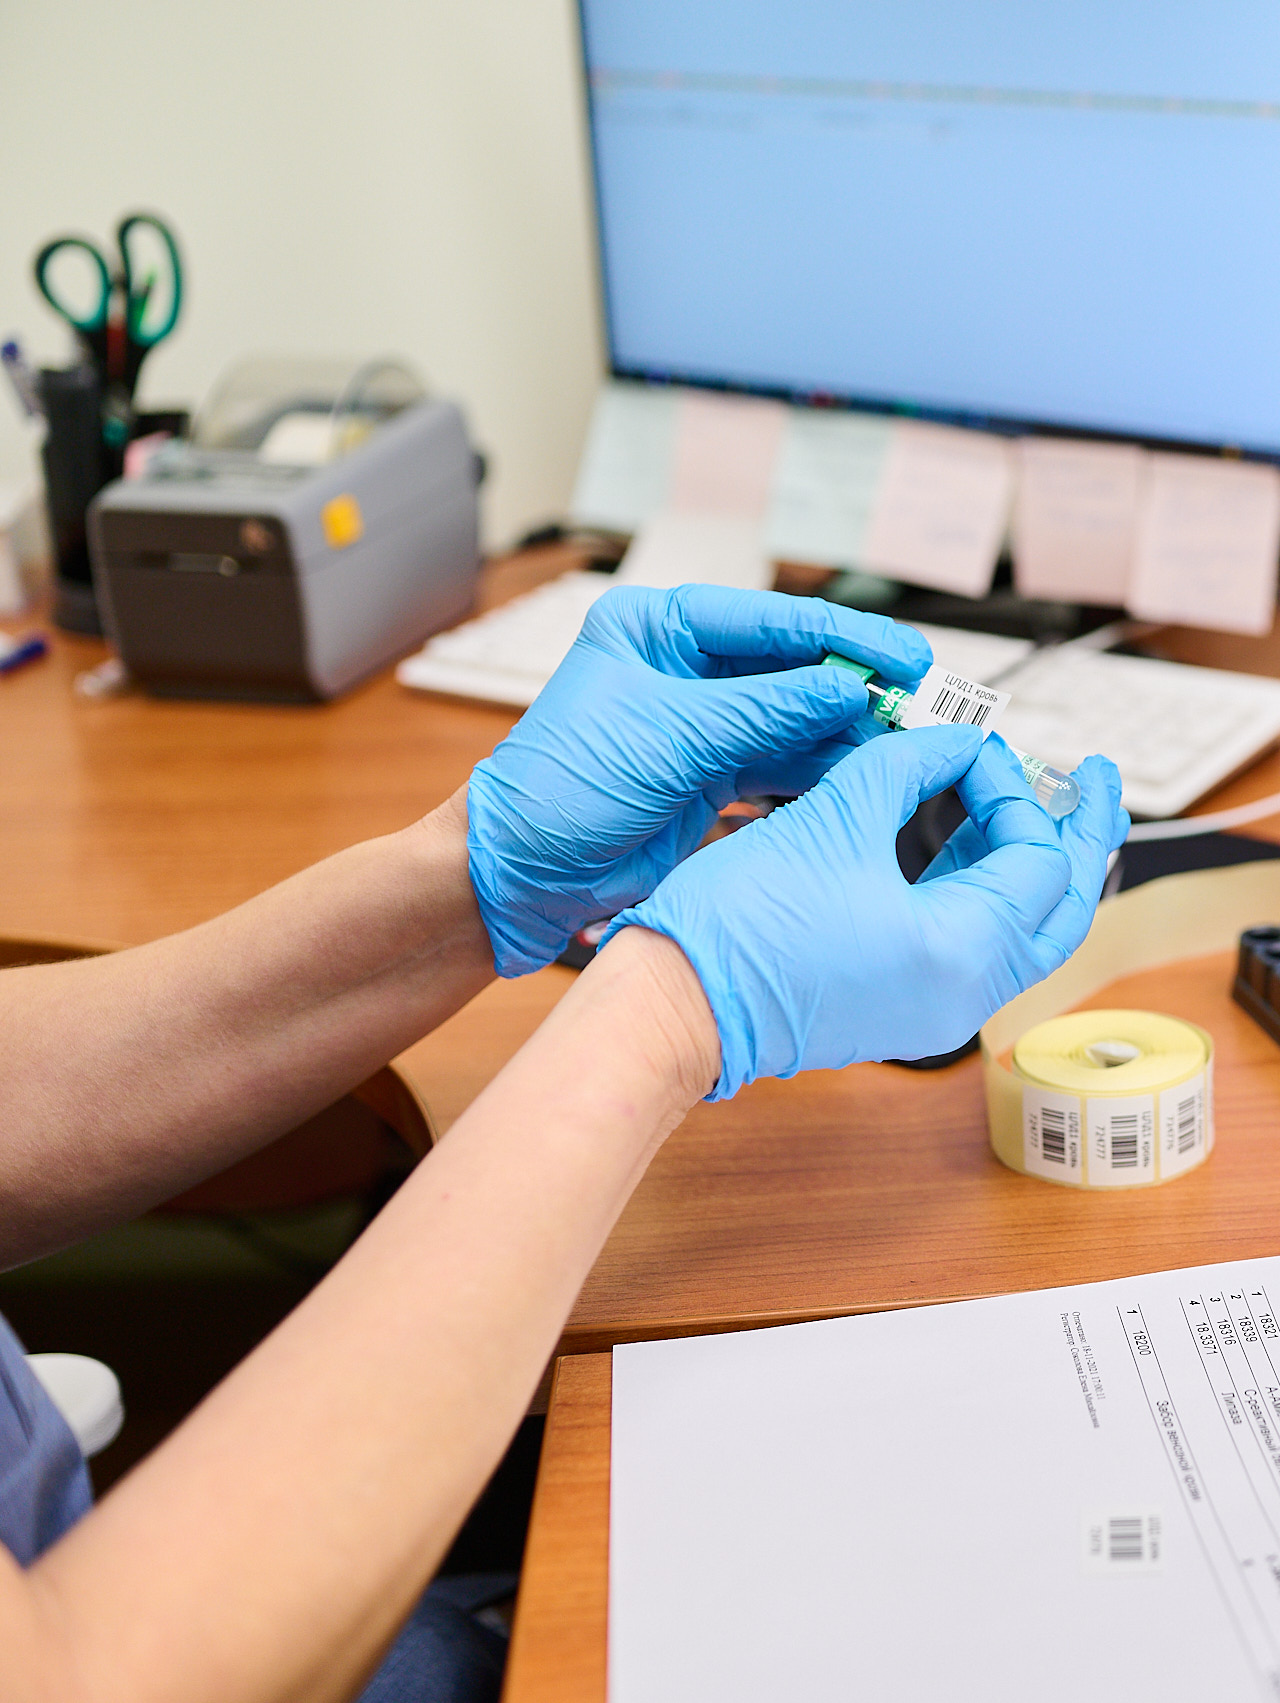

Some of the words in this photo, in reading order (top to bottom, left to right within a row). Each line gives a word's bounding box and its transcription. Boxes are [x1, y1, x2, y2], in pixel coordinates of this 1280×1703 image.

[974, 688, 998, 703] кровь
[1216, 1318, 1237, 1345] 18316
[1237, 1316, 1258, 1342] 18339
[1258, 1313, 1279, 1339] 18321
[1132, 1330, 1152, 1355] 18200
[1195, 1322, 1218, 1355] 18.3371
[1220, 1392, 1242, 1425] Липаза
